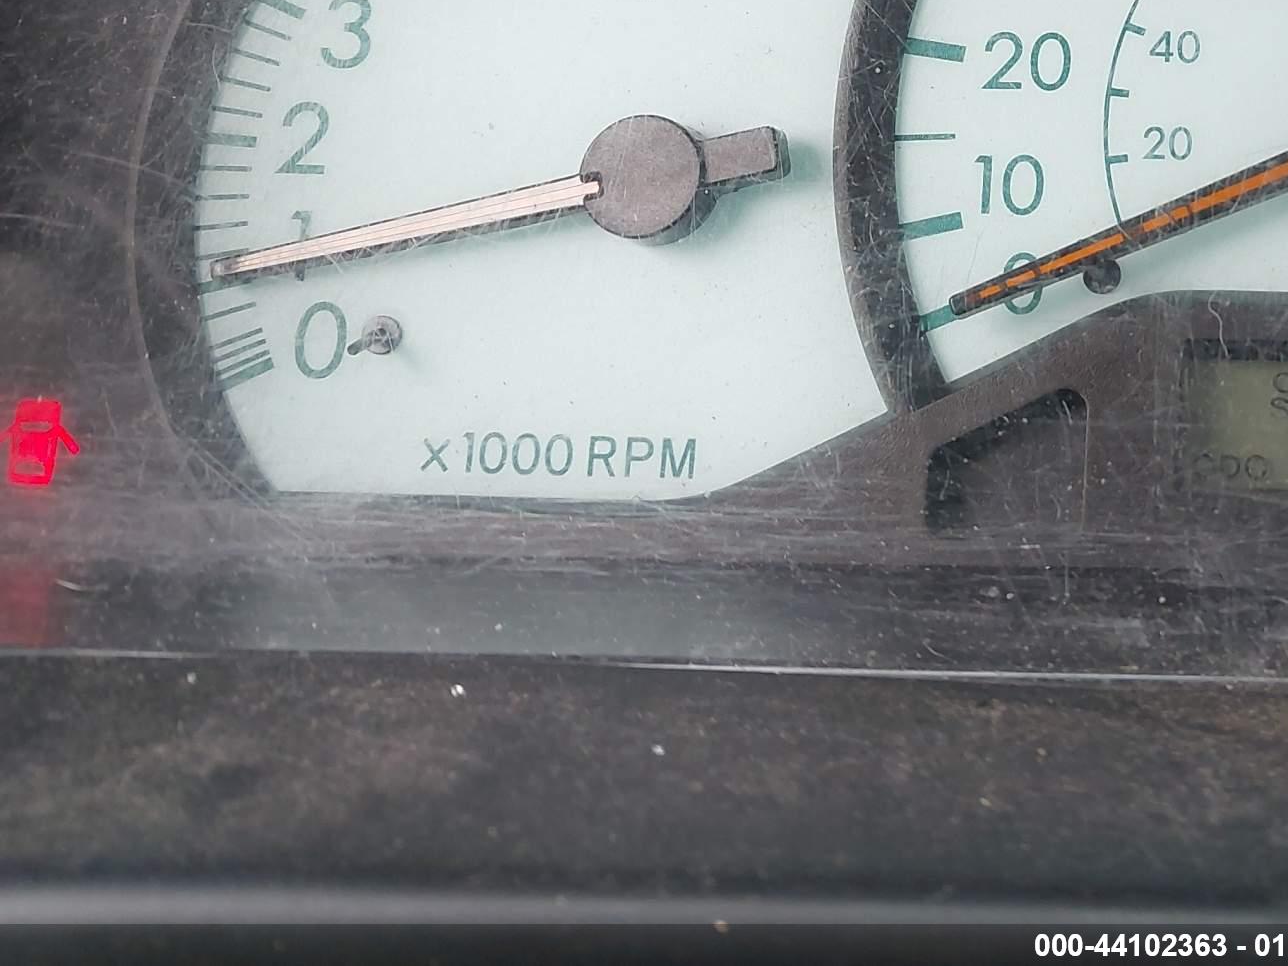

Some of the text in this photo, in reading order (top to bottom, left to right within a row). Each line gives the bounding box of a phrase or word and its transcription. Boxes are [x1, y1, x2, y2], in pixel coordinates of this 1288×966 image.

[981, 31, 1072, 92] 20
[1148, 30, 1200, 64] 40
[275, 102, 331, 176] 2
[1142, 126, 1193, 161] 20
[974, 154, 1044, 216] 10
[1002, 251, 1043, 316] 0
[293, 300, 348, 379] 0
[586, 436, 697, 480] RPM
